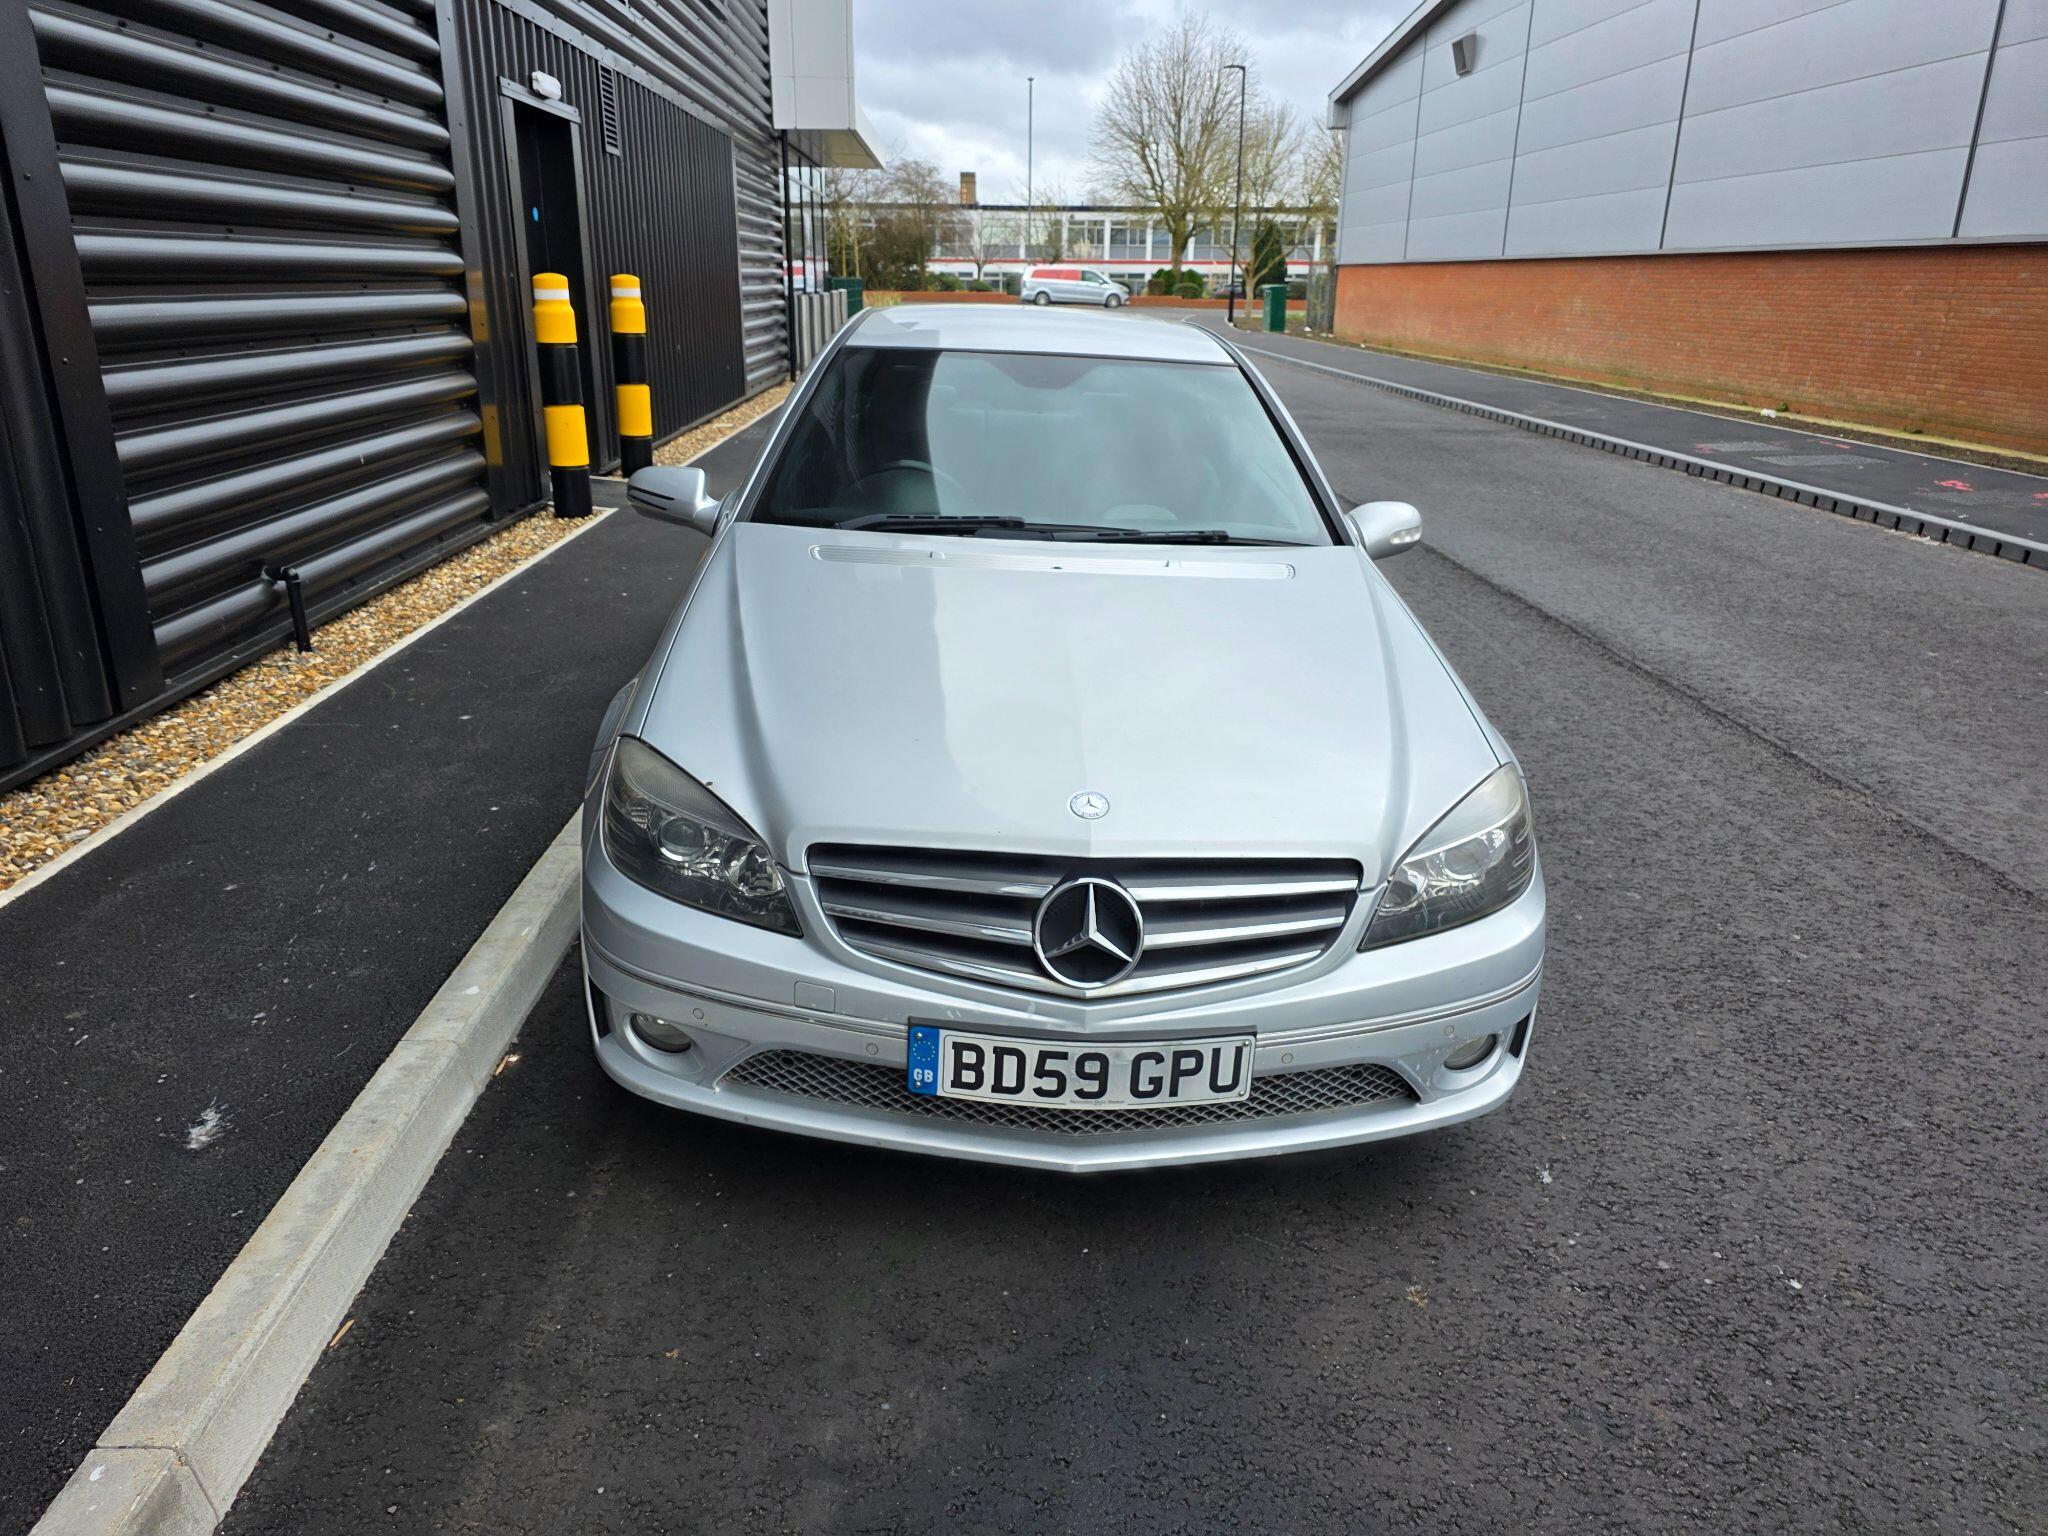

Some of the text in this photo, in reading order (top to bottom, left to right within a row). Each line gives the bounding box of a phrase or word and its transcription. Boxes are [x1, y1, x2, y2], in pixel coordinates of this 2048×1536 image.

[913, 1068, 933, 1083] GB
[950, 1041, 1243, 1100] BD59 GPU
